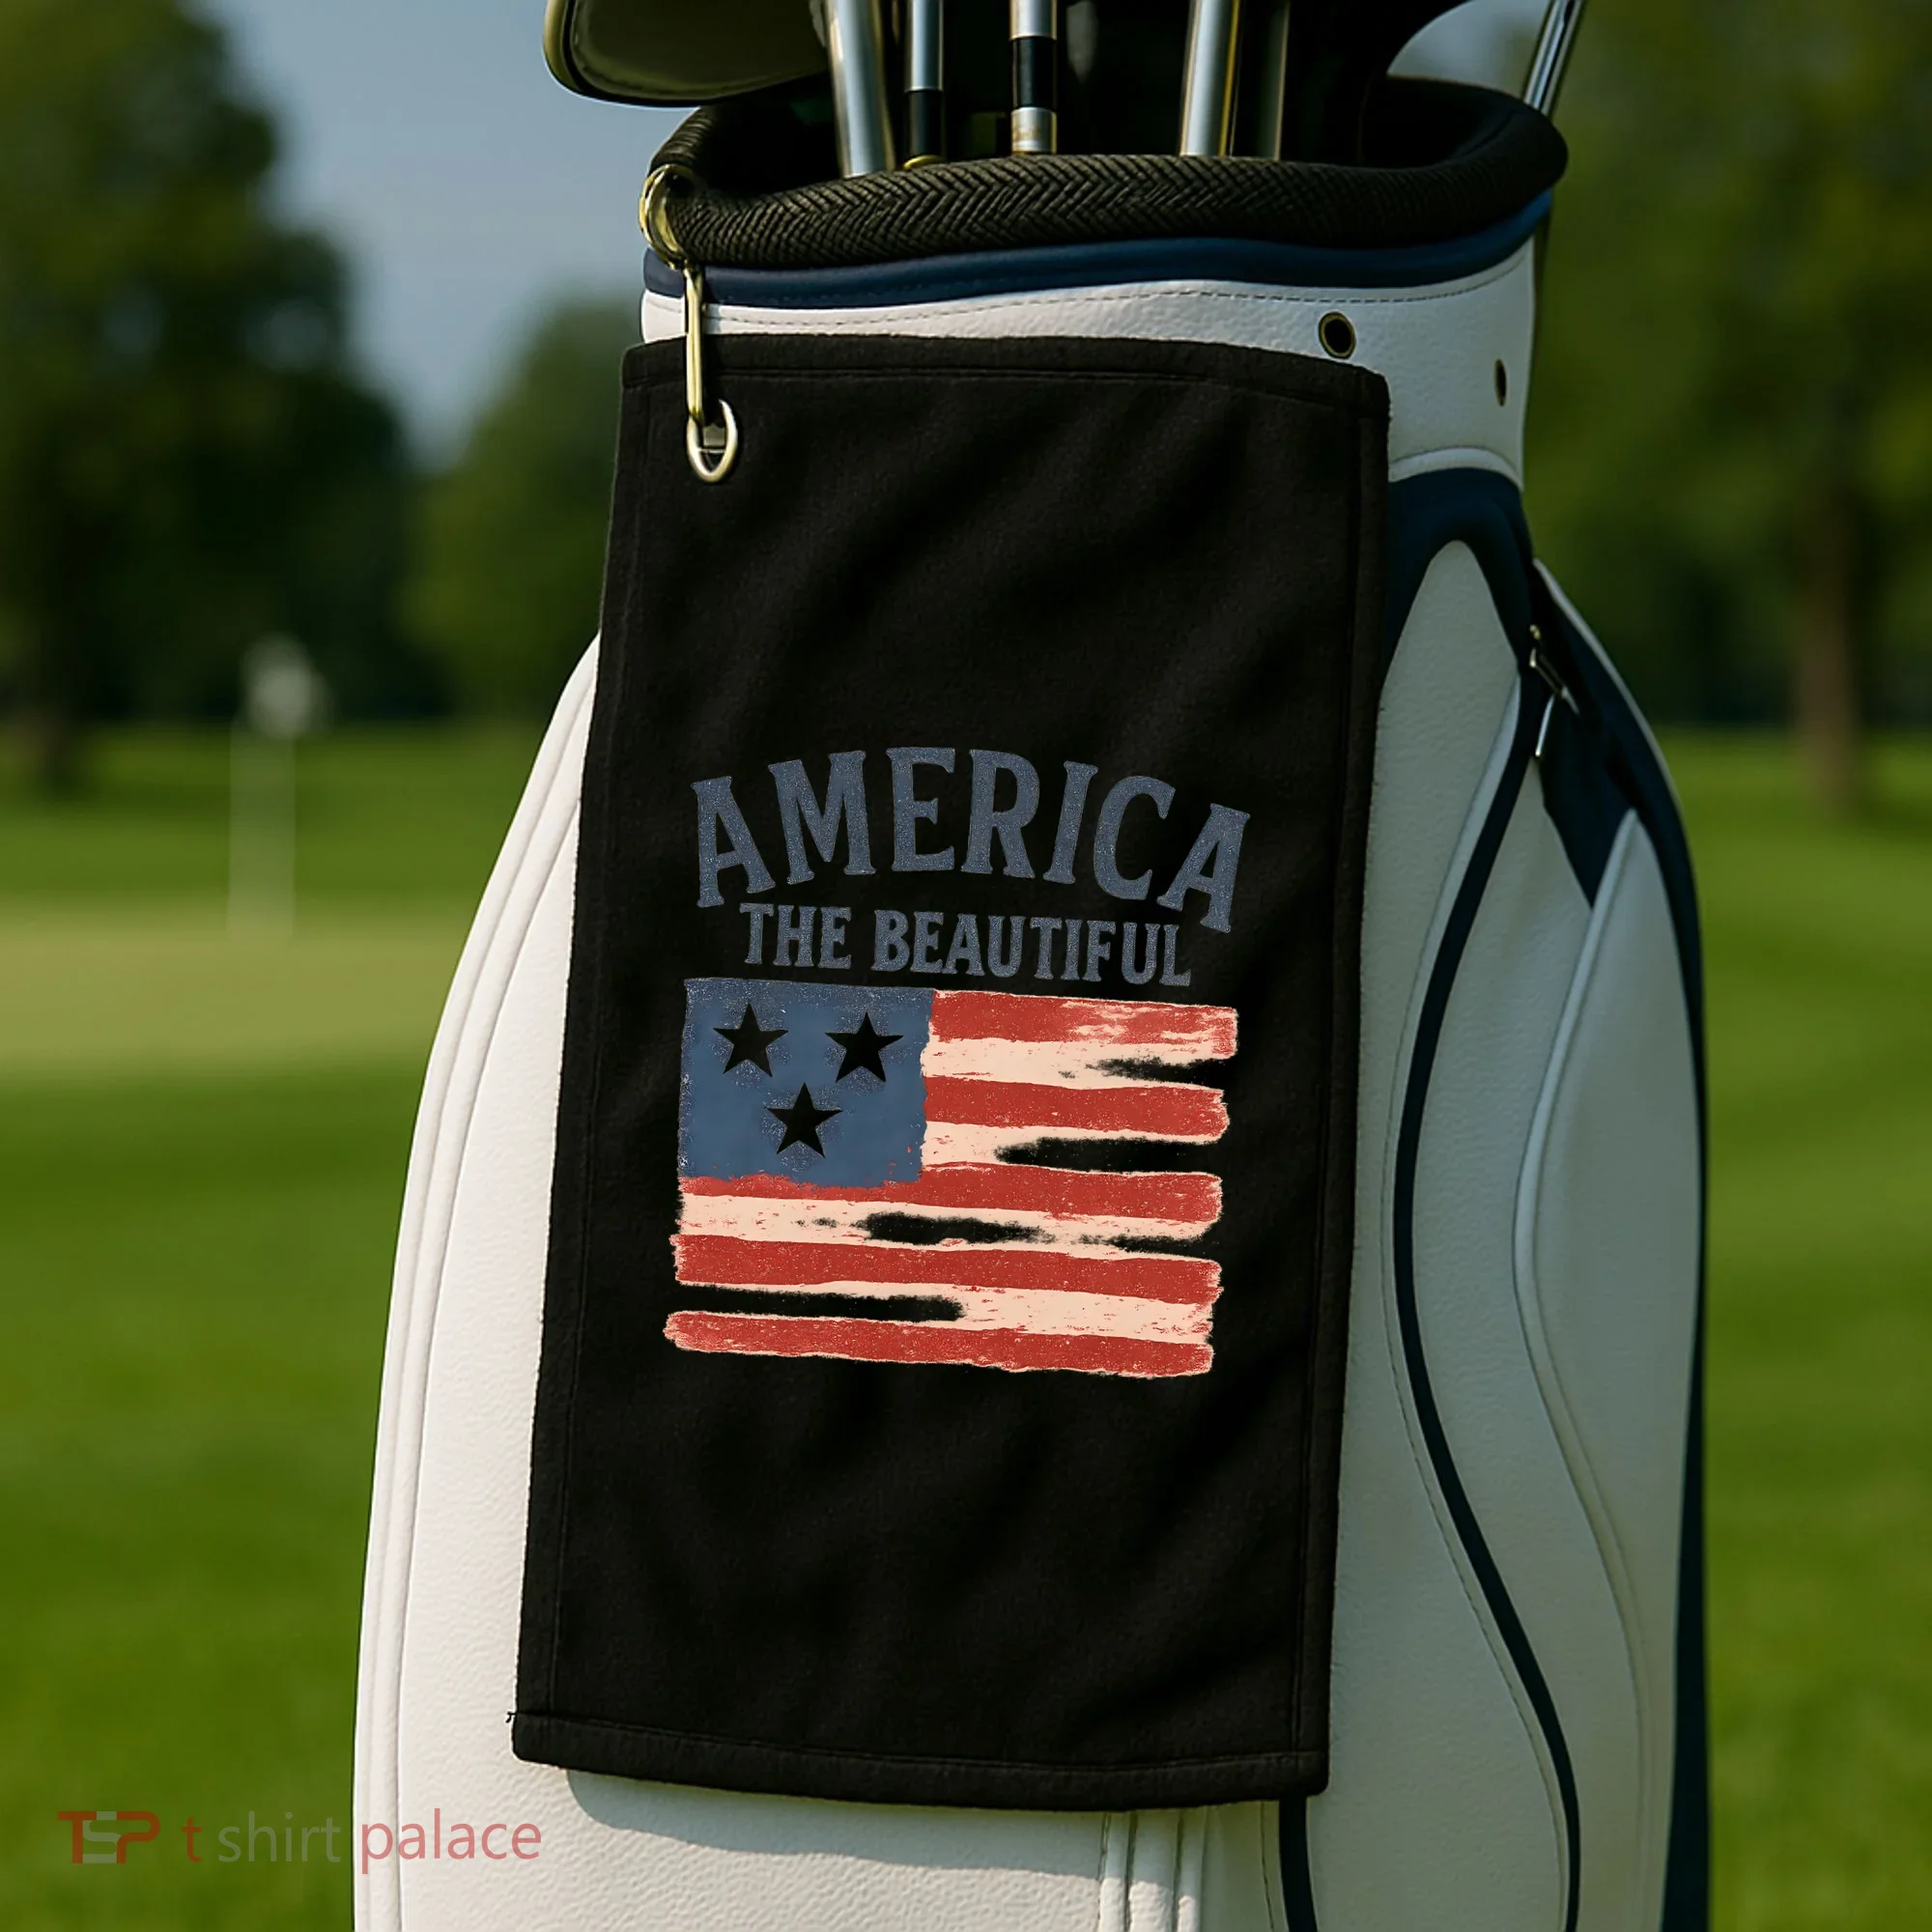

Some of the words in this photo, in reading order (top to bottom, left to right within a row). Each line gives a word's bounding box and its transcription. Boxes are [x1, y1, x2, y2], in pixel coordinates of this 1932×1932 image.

[691, 747, 1251, 933] AMERICA
[740, 902, 852, 969] THE
[870, 909, 1192, 986] BEAUTIFUL
